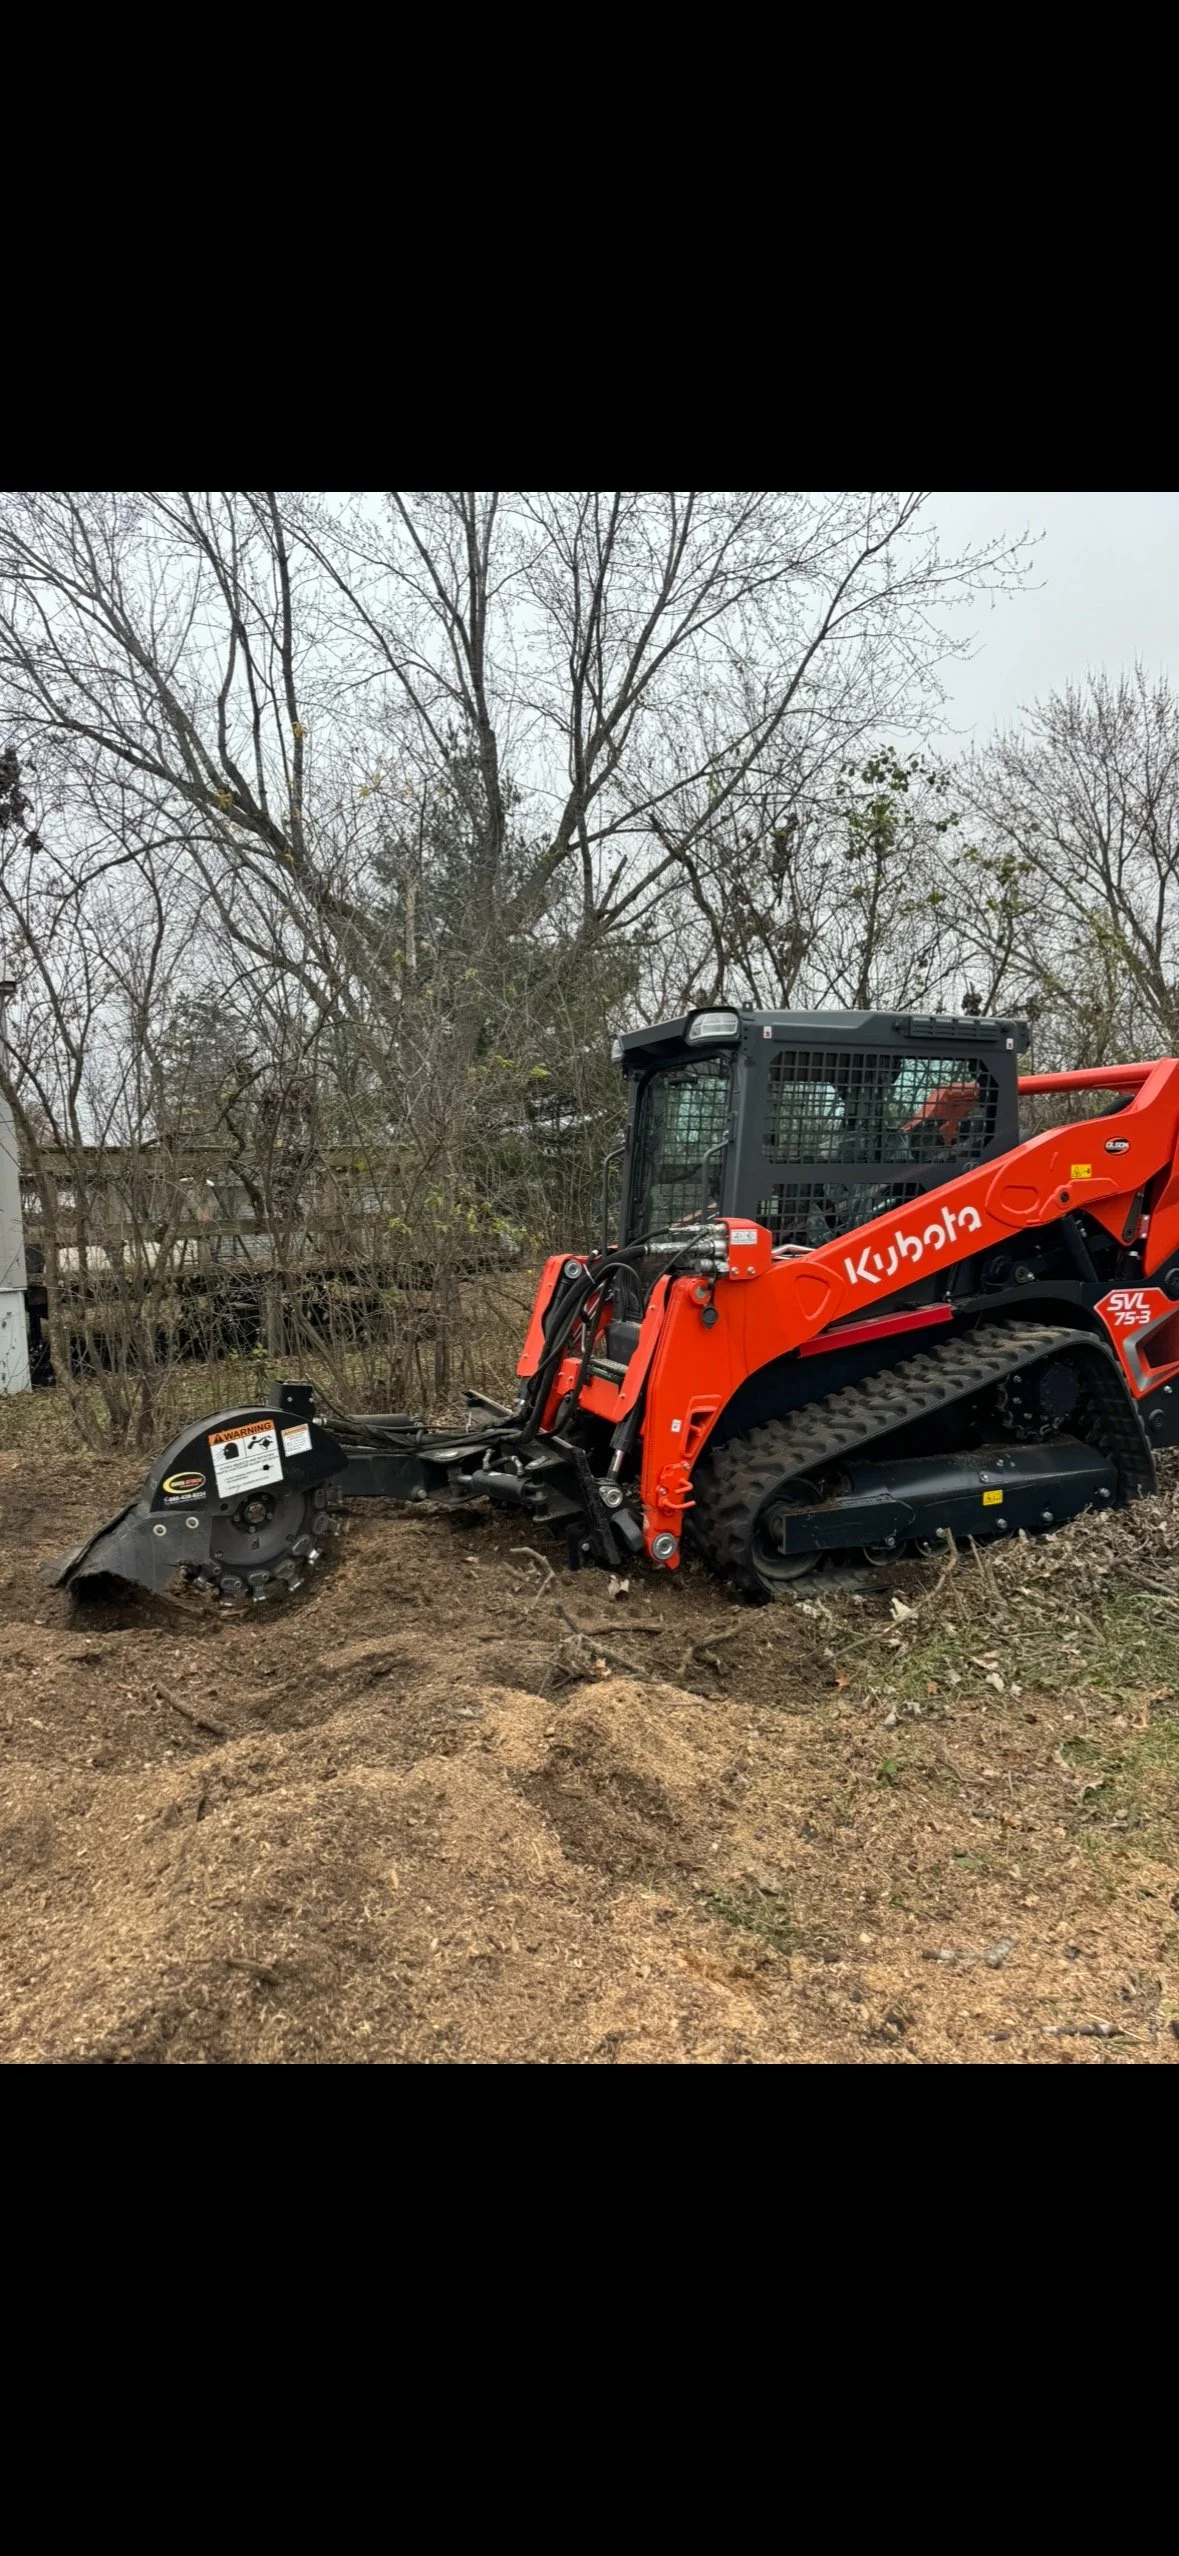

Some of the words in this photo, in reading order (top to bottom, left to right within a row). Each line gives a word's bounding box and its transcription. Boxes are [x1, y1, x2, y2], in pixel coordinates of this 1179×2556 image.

[844, 1206, 982, 1285] Kubota
[1107, 1292, 1150, 1311] SVL
[1114, 1310, 1151, 1326] 75-3
[223, 1422, 272, 1441] WARNING
